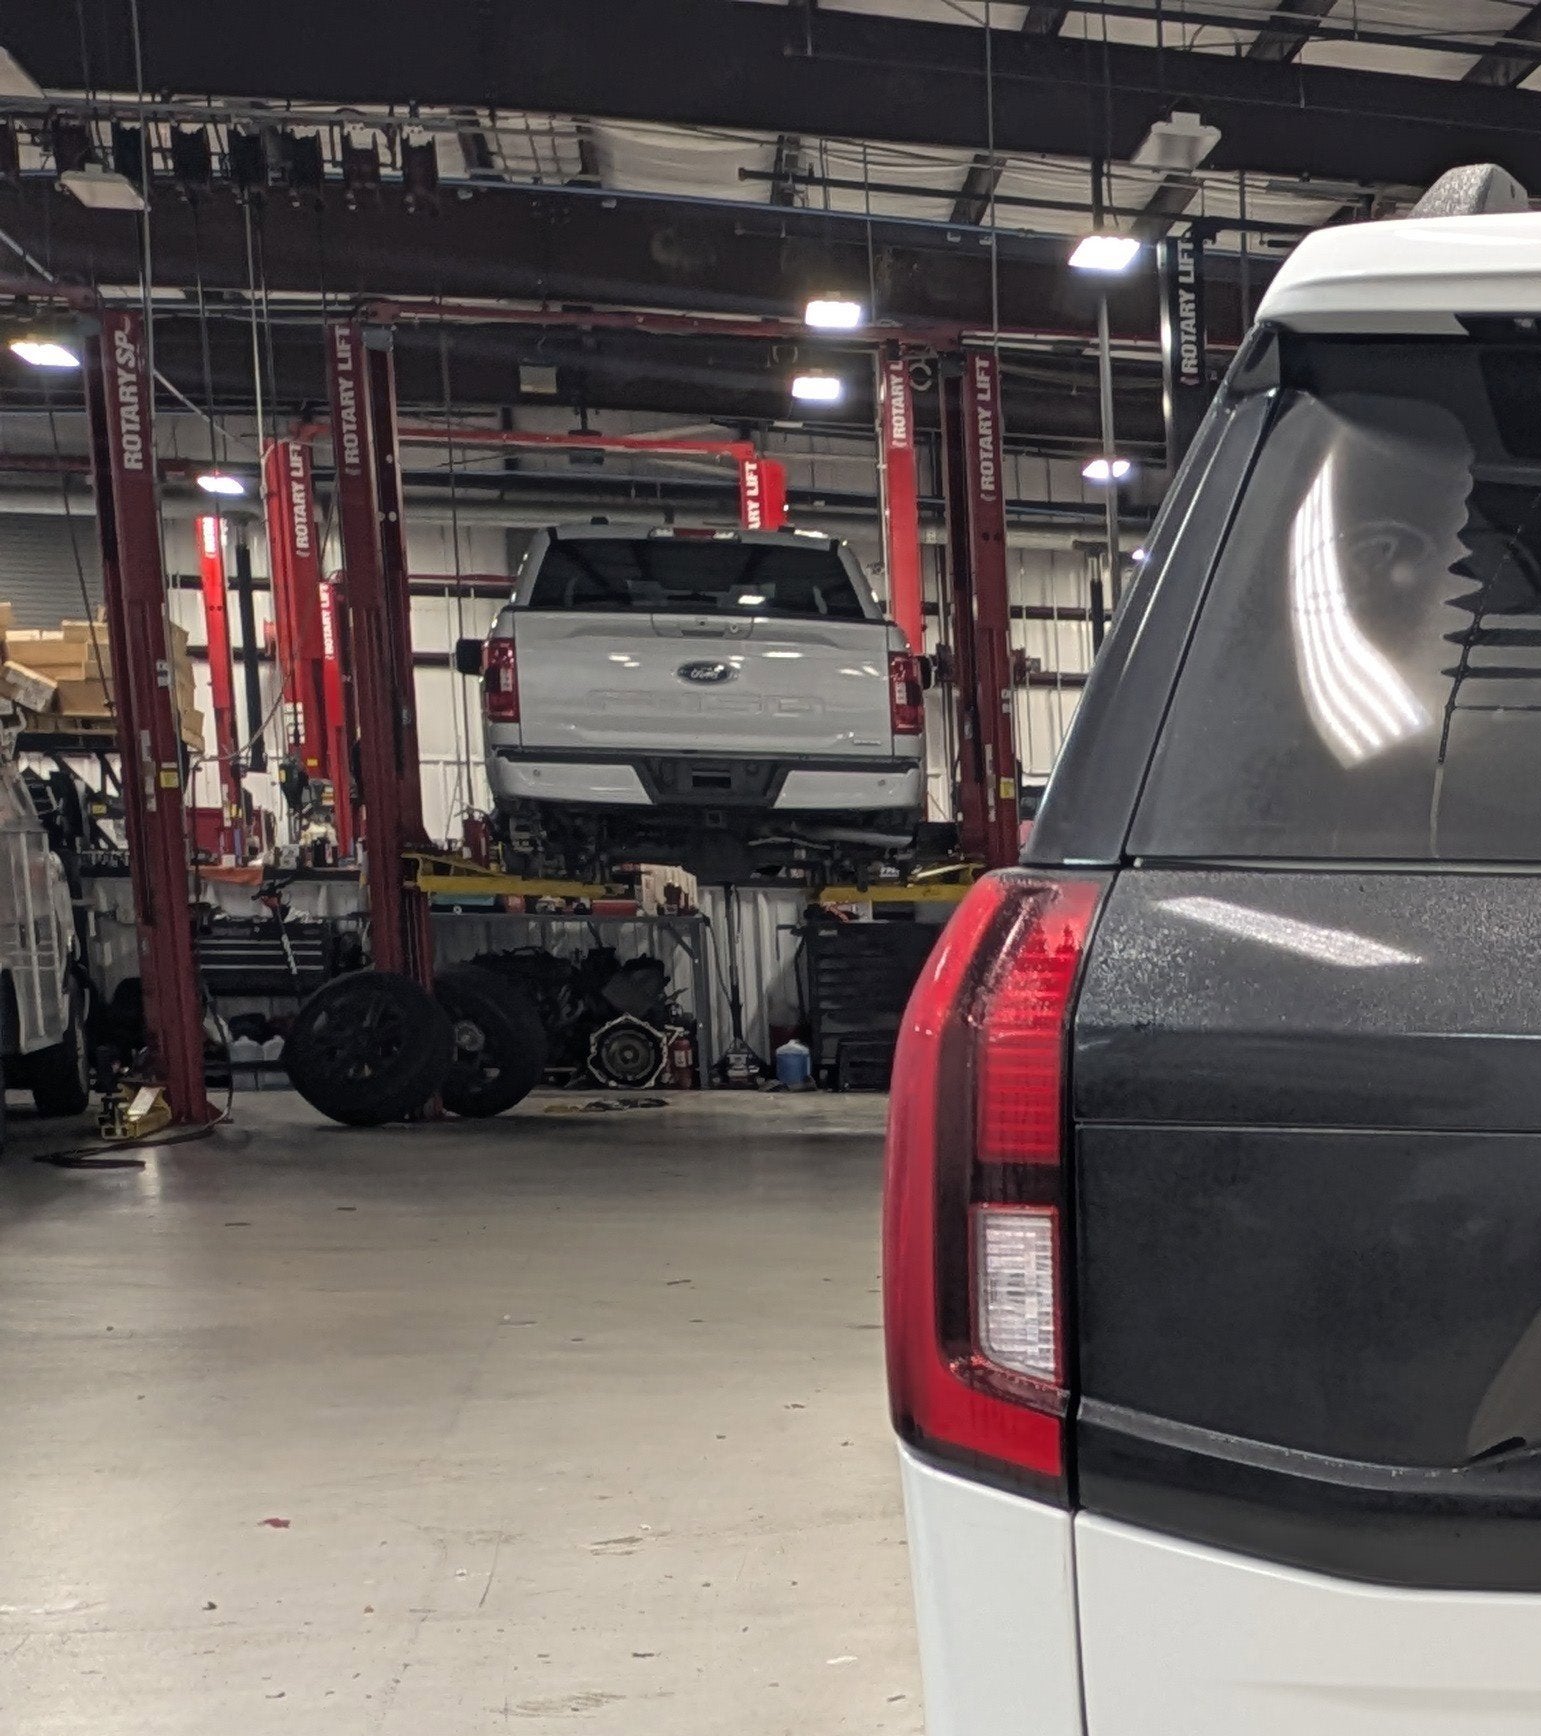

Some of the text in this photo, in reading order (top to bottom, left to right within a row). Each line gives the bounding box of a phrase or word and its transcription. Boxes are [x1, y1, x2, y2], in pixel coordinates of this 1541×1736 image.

[1177, 239, 1199, 374] ROTARY LIFT
[117, 367, 143, 470] ROTARY
[334, 325, 361, 465] ROTARY LIFT
[889, 373, 907, 441] ROTARY
[975, 355, 996, 493] ROTARY LIFT
[288, 441, 310, 549] ROTARY LIFT
[745, 461, 760, 497] LIFT
